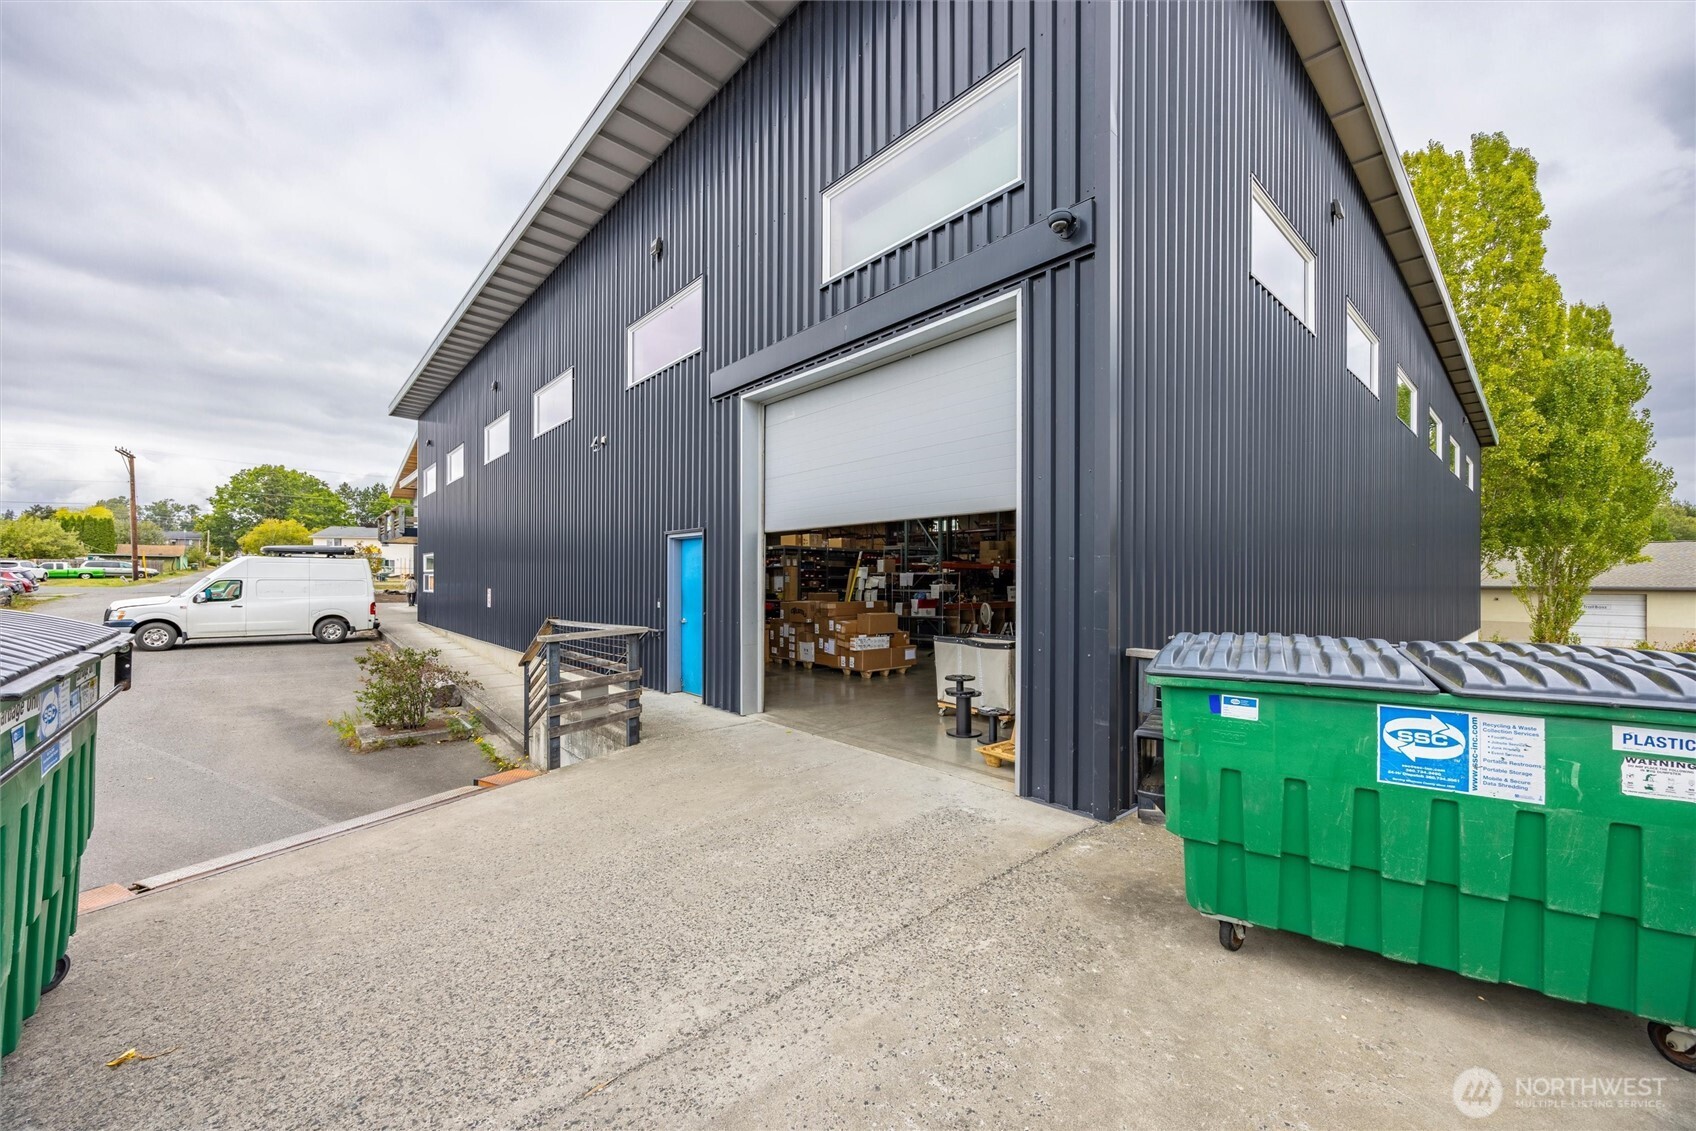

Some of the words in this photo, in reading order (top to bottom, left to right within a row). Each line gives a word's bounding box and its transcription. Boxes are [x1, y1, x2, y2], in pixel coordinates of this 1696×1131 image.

[0, 700, 24, 726] arbage
[1397, 730, 1448, 746] SSC
[1623, 733, 1696, 751] PLASTIC
[1625, 757, 1696, 770] WARNING
[1498, 782, 1528, 791] Shredding
